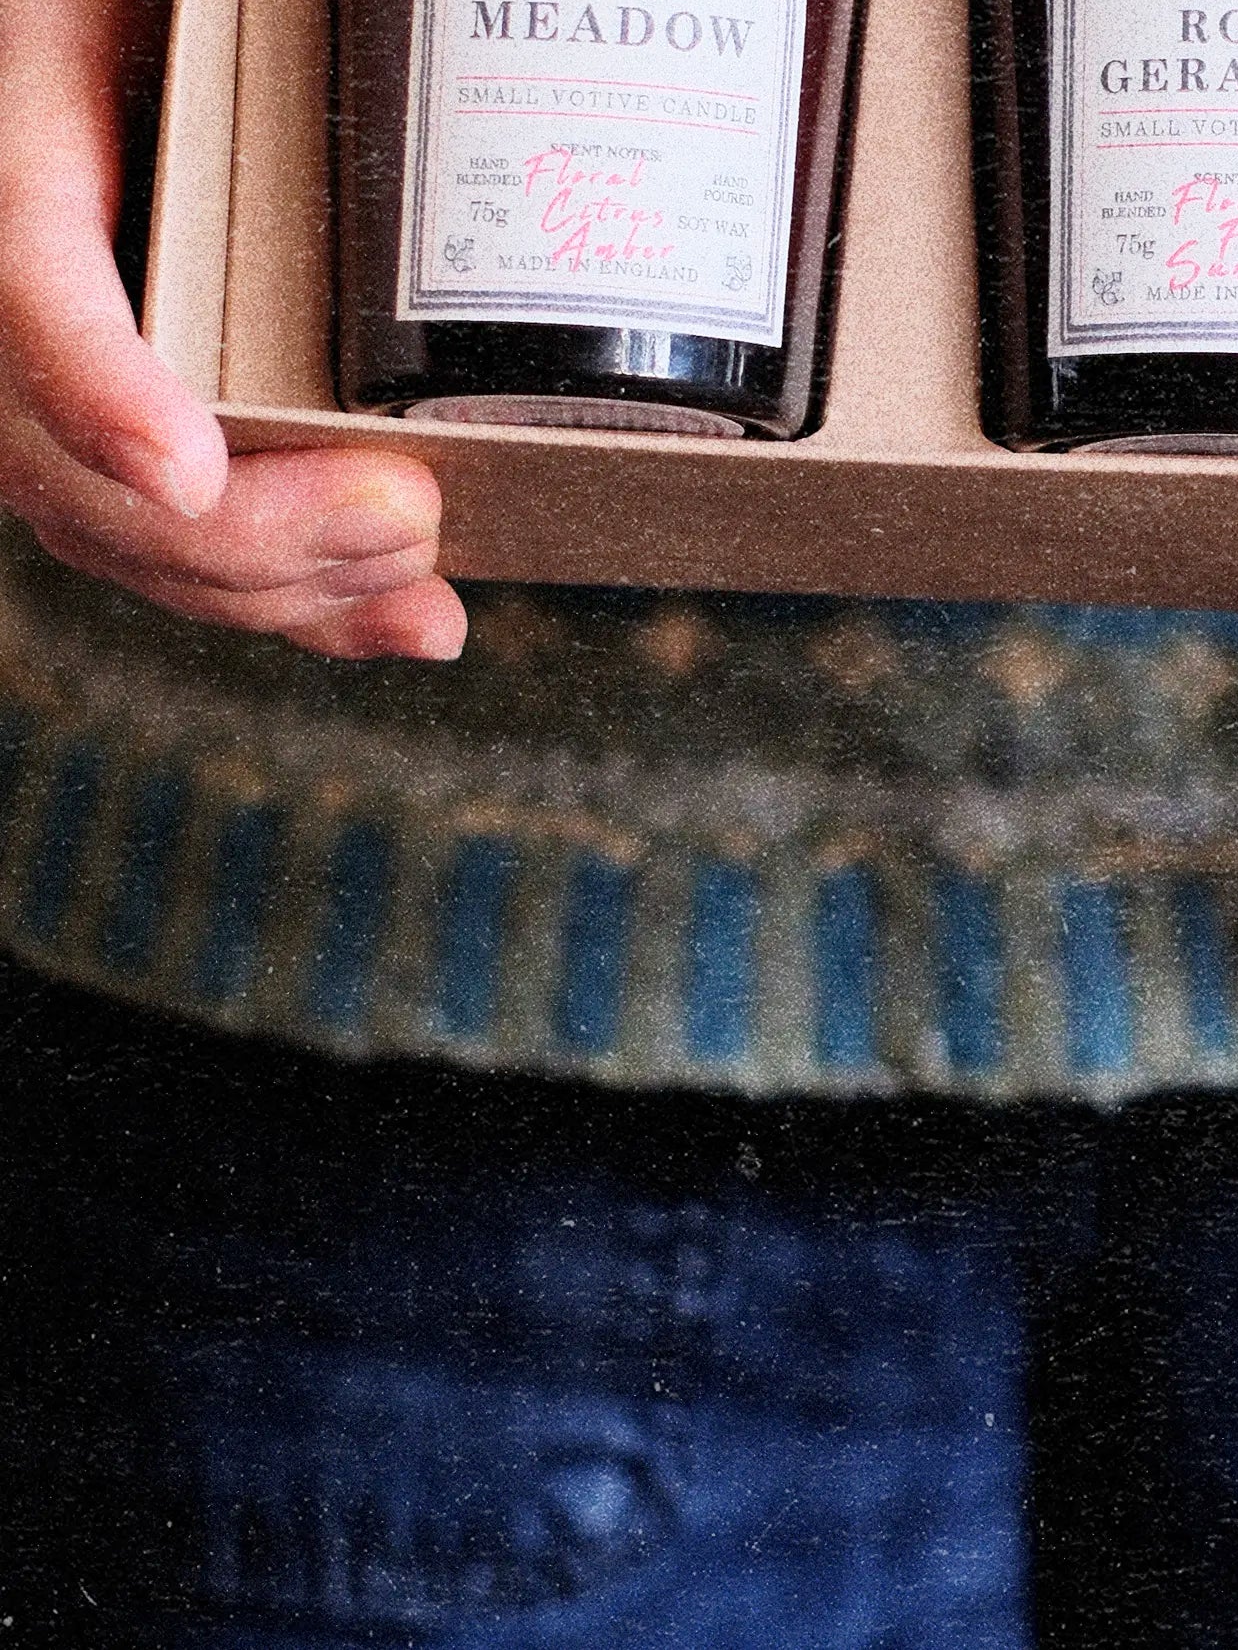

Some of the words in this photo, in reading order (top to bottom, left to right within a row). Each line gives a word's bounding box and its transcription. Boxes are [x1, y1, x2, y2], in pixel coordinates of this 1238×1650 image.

[470, 0, 755, 58] MEADOW
[458, 87, 539, 106] SMALL
[552, 89, 647, 111] VOTIVE
[663, 97, 756, 125] CANDLE
[1101, 121, 1180, 138] SMALL
[551, 143, 602, 159] SCENT
[469, 158, 509, 170] HAND
[524, 148, 646, 197] Floral
[456, 173, 522, 186] BLENDED
[712, 173, 748, 189] HAND
[704, 189, 754, 206] POURED
[1115, 190, 1154, 203] HAND
[470, 201, 510, 228] 75g
[541, 188, 664, 233] Citrus
[1102, 206, 1166, 218] BLENDED
[678, 216, 712, 232] SOY
[716, 221, 749, 238] WAX
[552, 223, 675, 272] Amber
[1116, 234, 1155, 259] 75g
[499, 256, 556, 271] MADE
[568, 258, 589, 271] IN
[600, 259, 699, 282] ENGLAND
[1147, 286, 1205, 301] MADE
[1217, 286, 1238, 301] IN
